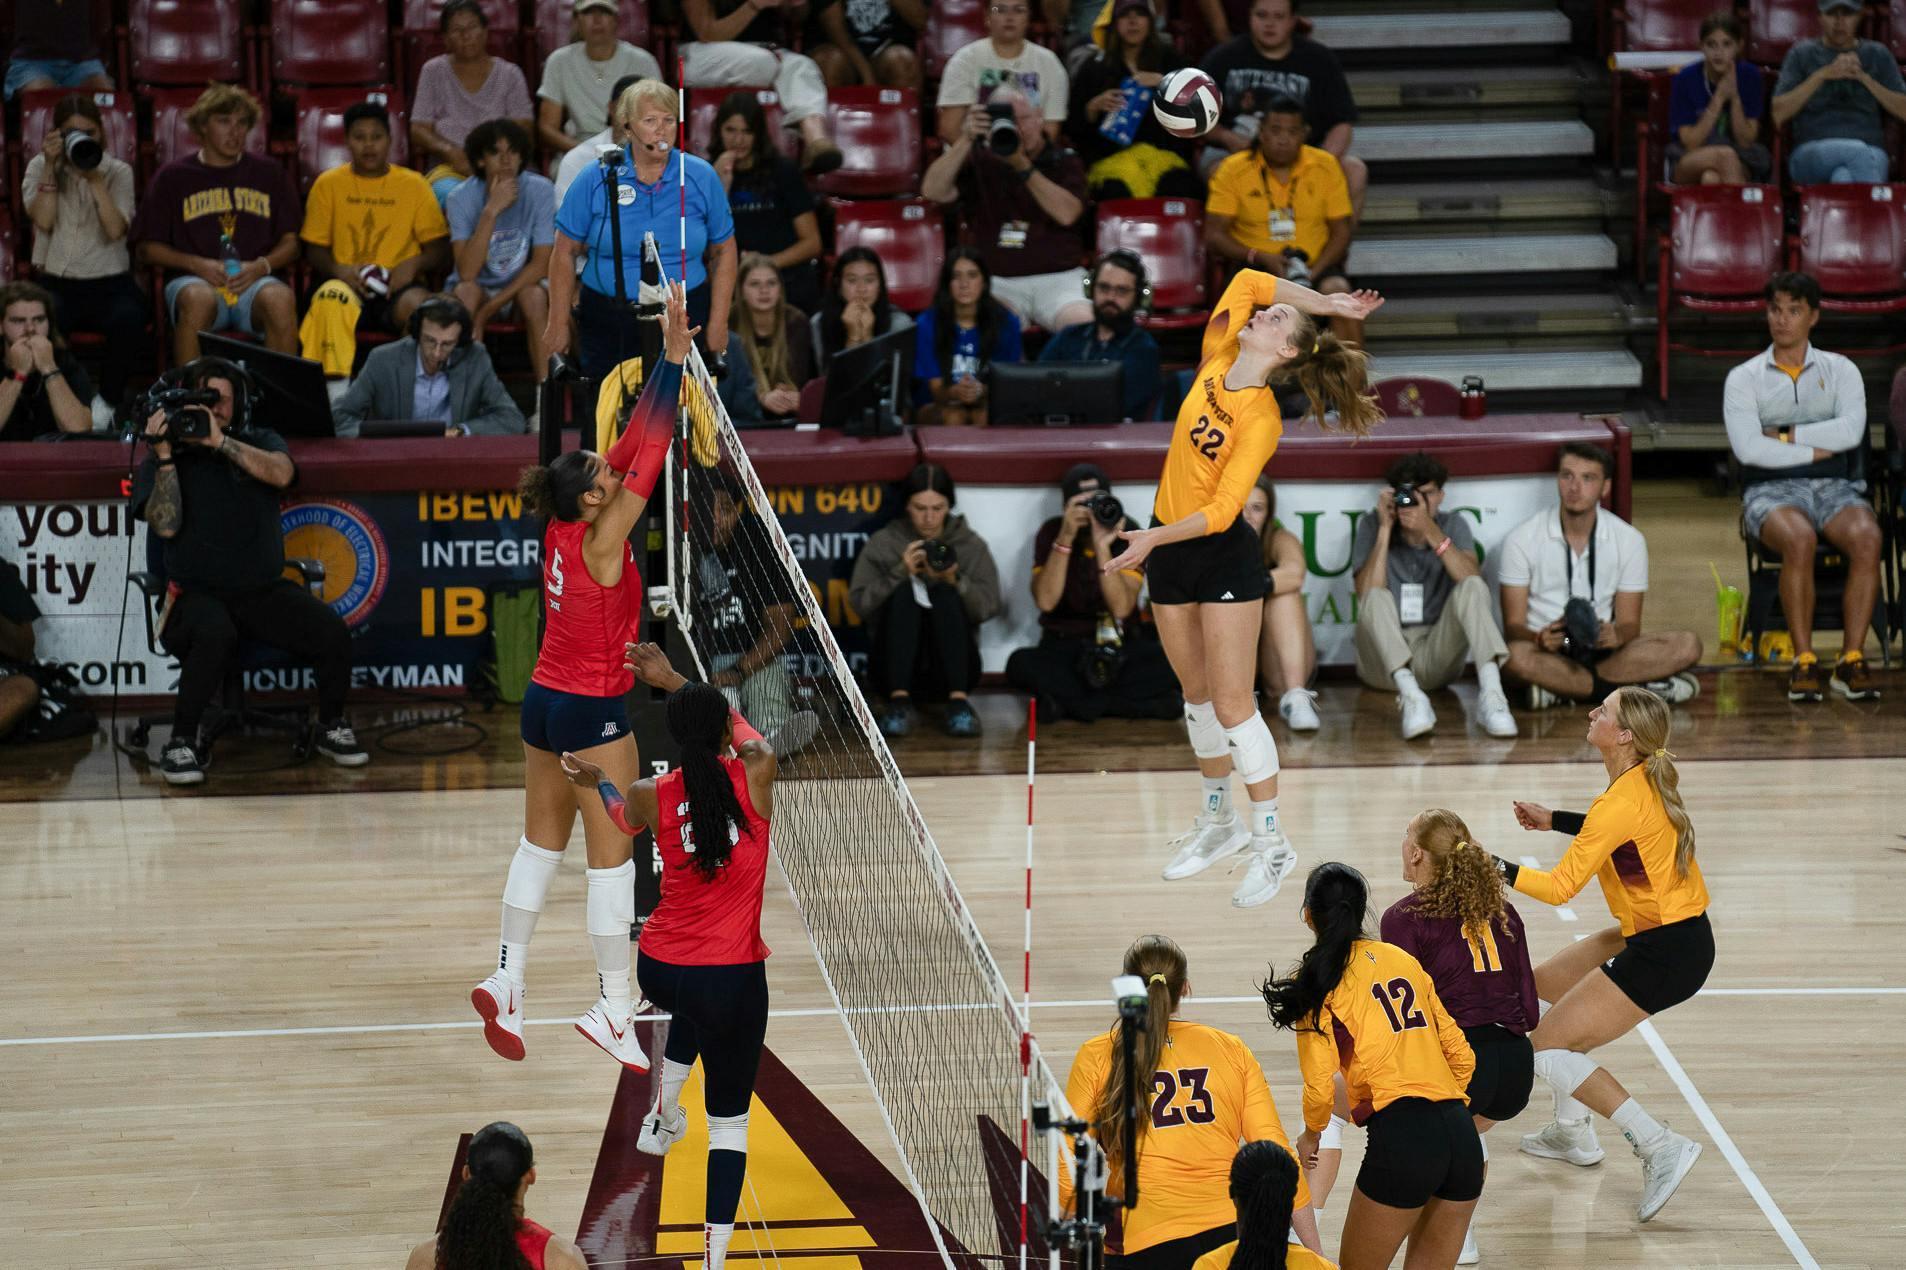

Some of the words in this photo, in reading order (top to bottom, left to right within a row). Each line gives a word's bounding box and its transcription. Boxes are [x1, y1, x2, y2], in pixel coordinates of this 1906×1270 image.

[183, 188, 233, 222] ARIZONA
[233, 187, 271, 218] STATE
[1190, 415, 1225, 462] 22
[419, 491, 522, 521] IBEW
[815, 485, 883, 515] 640
[421, 539, 540, 567] INTEGR
[786, 532, 872, 562] GNIT
[548, 547, 564, 597] 5
[26, 552, 97, 605] ity
[421, 586, 488, 637] IB
[62, 660, 146, 686] com
[1460, 919, 1503, 973] 11
[1370, 977, 1428, 1034] 12
[1150, 1066, 1216, 1129] 23
